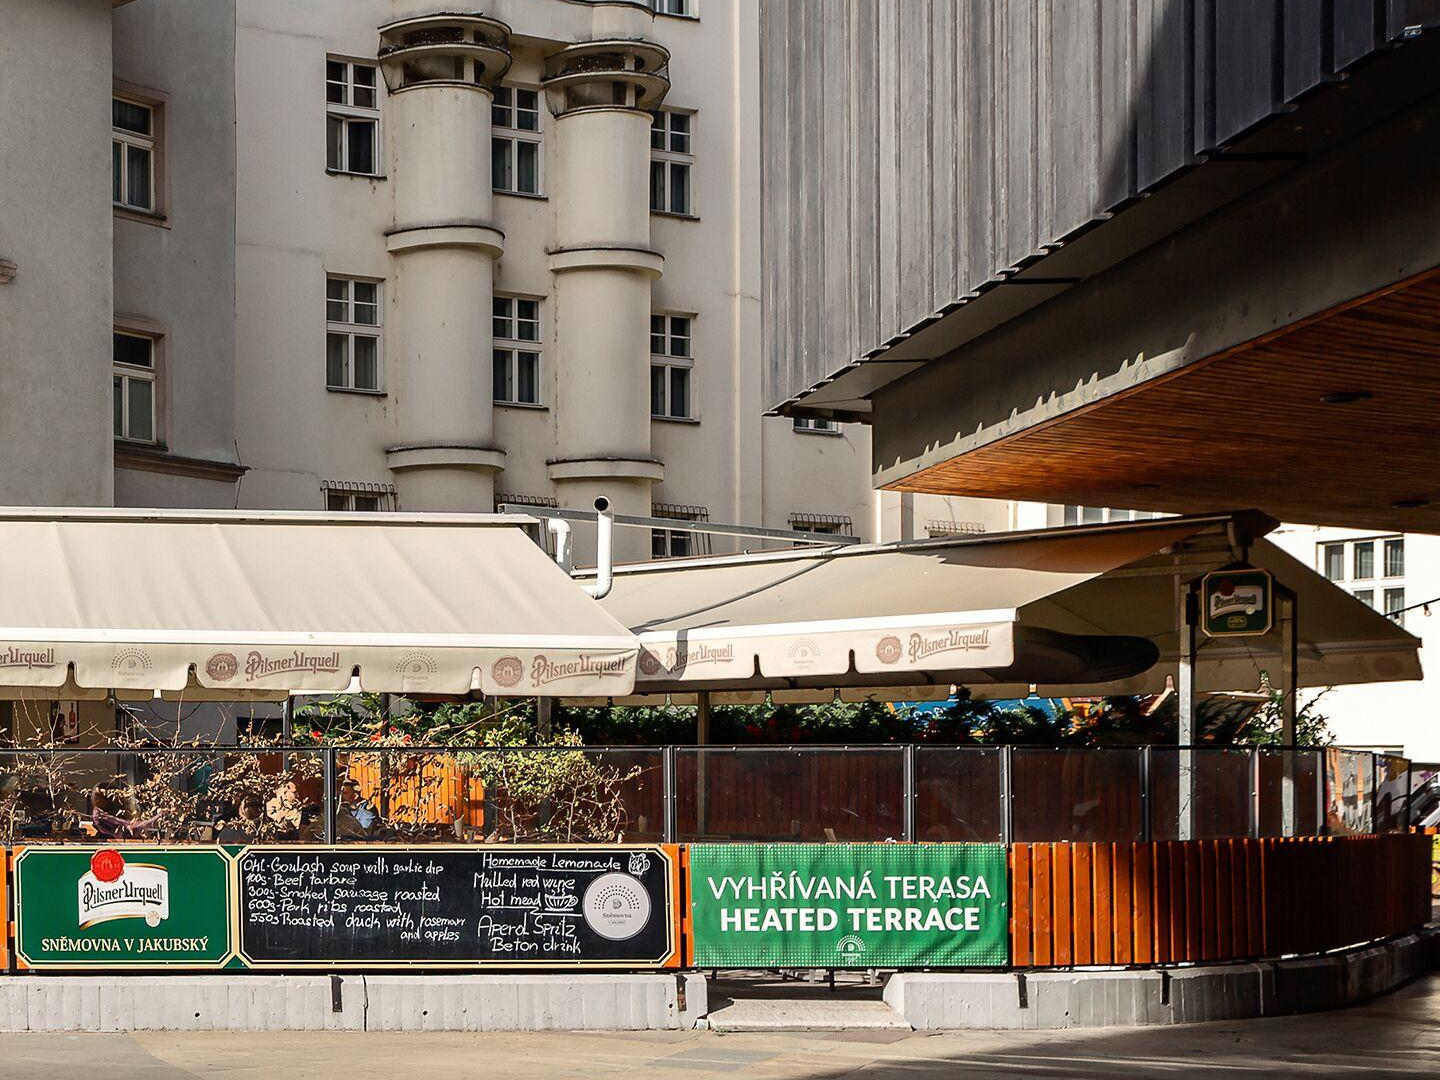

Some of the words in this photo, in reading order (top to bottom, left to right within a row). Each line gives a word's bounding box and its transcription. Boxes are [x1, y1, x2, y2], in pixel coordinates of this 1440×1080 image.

[908, 633, 951, 663] Pilsner
[949, 629, 990, 651] Urquell
[8, 646, 55, 669] Urquell
[245, 651, 295, 682] Pilsner
[293, 650, 340, 674] Urquell
[530, 655, 581, 687] Pilsner
[578, 654, 626, 679] Urquell
[330, 863, 360, 875] soup
[393, 858, 422, 875] garlic
[425, 860, 444, 875] dip
[482, 853, 546, 869] Homemade
[552, 853, 621, 869] Lemonade
[333, 888, 389, 901] sausage
[394, 881, 440, 901] roasted
[473, 872, 517, 889] Mulled
[522, 875, 539, 889] red
[543, 878, 576, 892] wine
[708, 871, 877, 900] VYHŘÍVANÁ
[884, 875, 991, 899] TERASA
[83, 881, 124, 913] Pilsner
[123, 880, 163, 906] Urquell
[481, 890, 505, 906] Hot
[510, 892, 541, 906] mead
[317, 900, 347, 914] ribs
[354, 902, 402, 915] roasted
[345, 912, 380, 929] duck
[386, 912, 414, 929] with
[478, 912, 529, 937] Aperol
[533, 915, 576, 937] Spritz
[720, 907, 839, 931] HEATED
[847, 907, 980, 931] TERRACE
[400, 926, 419, 941] and
[424, 926, 460, 941] apples
[42, 936, 121, 952] SNĚMOVNA
[124, 938, 134, 952] V
[137, 936, 209, 953] JAKUBSKÝ
[490, 937, 538, 952] Beton
[543, 936, 581, 954] drink
